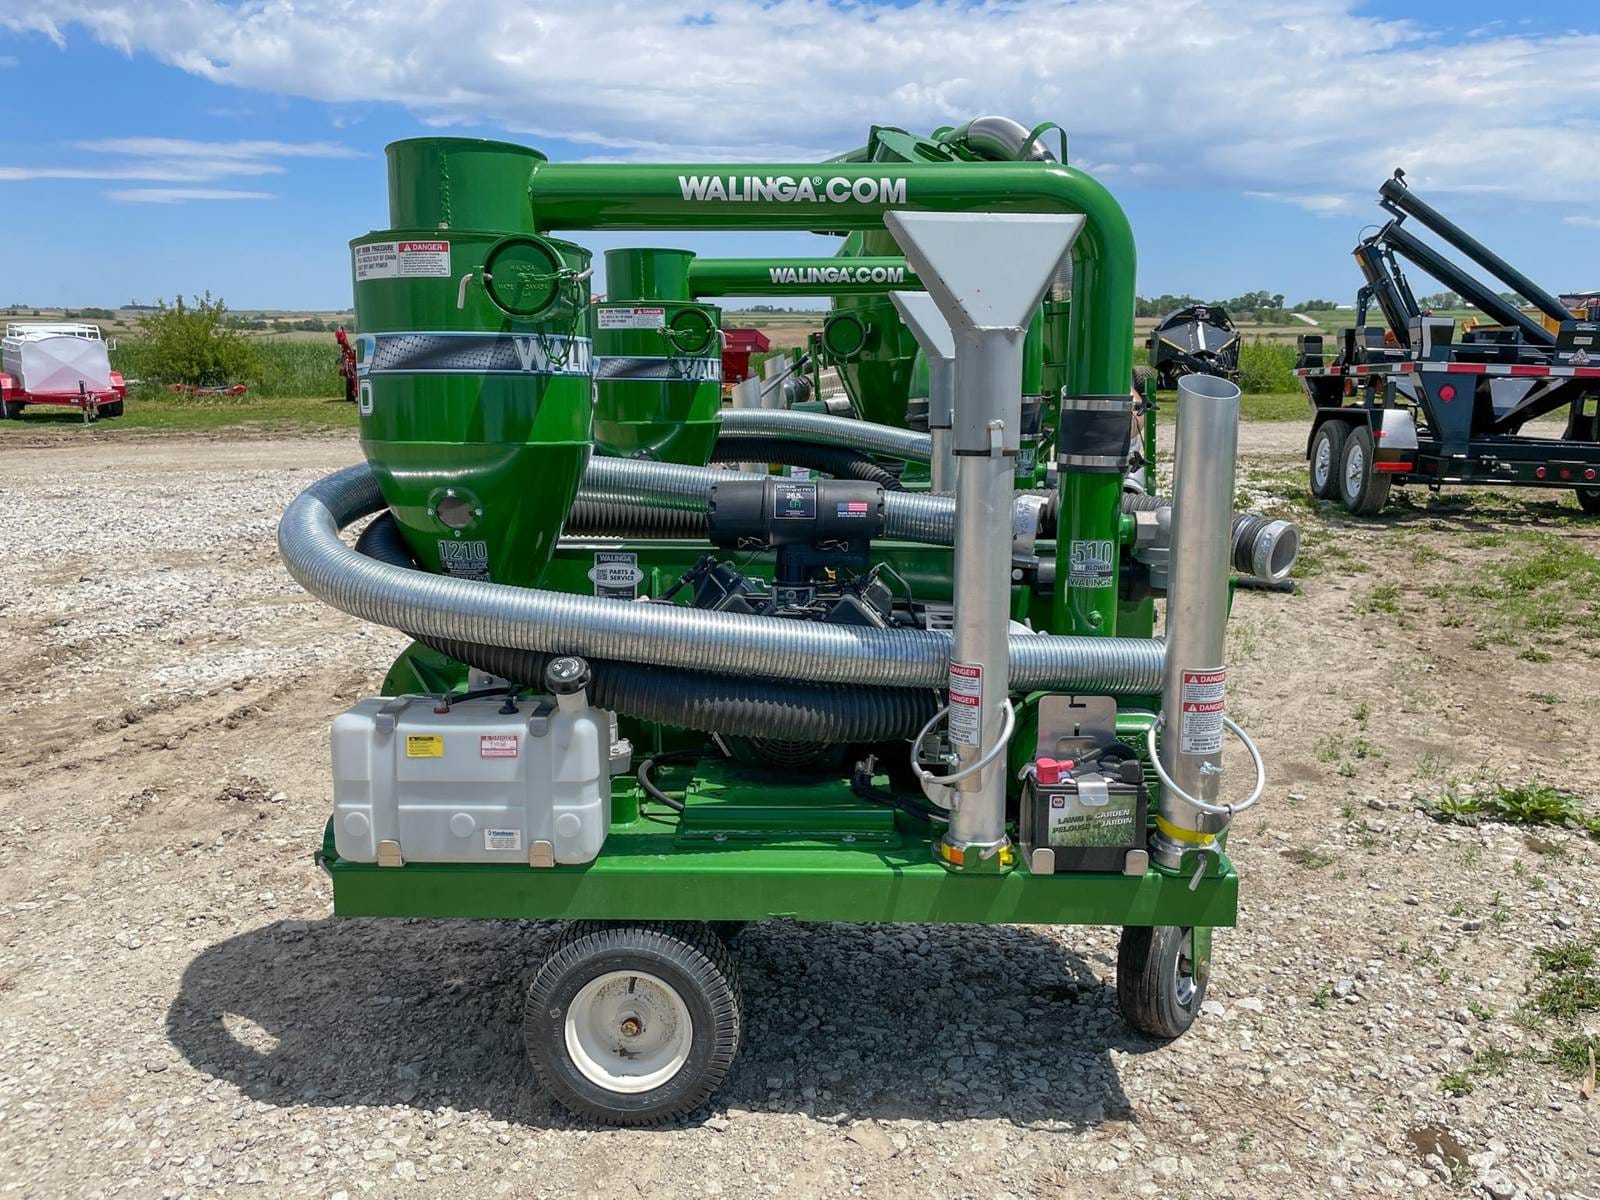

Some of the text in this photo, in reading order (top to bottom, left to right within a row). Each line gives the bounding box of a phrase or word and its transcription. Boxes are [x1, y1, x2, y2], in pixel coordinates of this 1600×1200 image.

[412, 243, 442, 251] DANGER
[439, 541, 488, 560] 1210
[600, 554, 632, 562] WALINGA
[1071, 541, 1114, 565] 510
[1052, 822, 1091, 834] PELOUSE
[1101, 816, 1133, 827] JARDIN
[1058, 815, 1085, 825] LAWN
[1094, 808, 1131, 819] GARDEN
